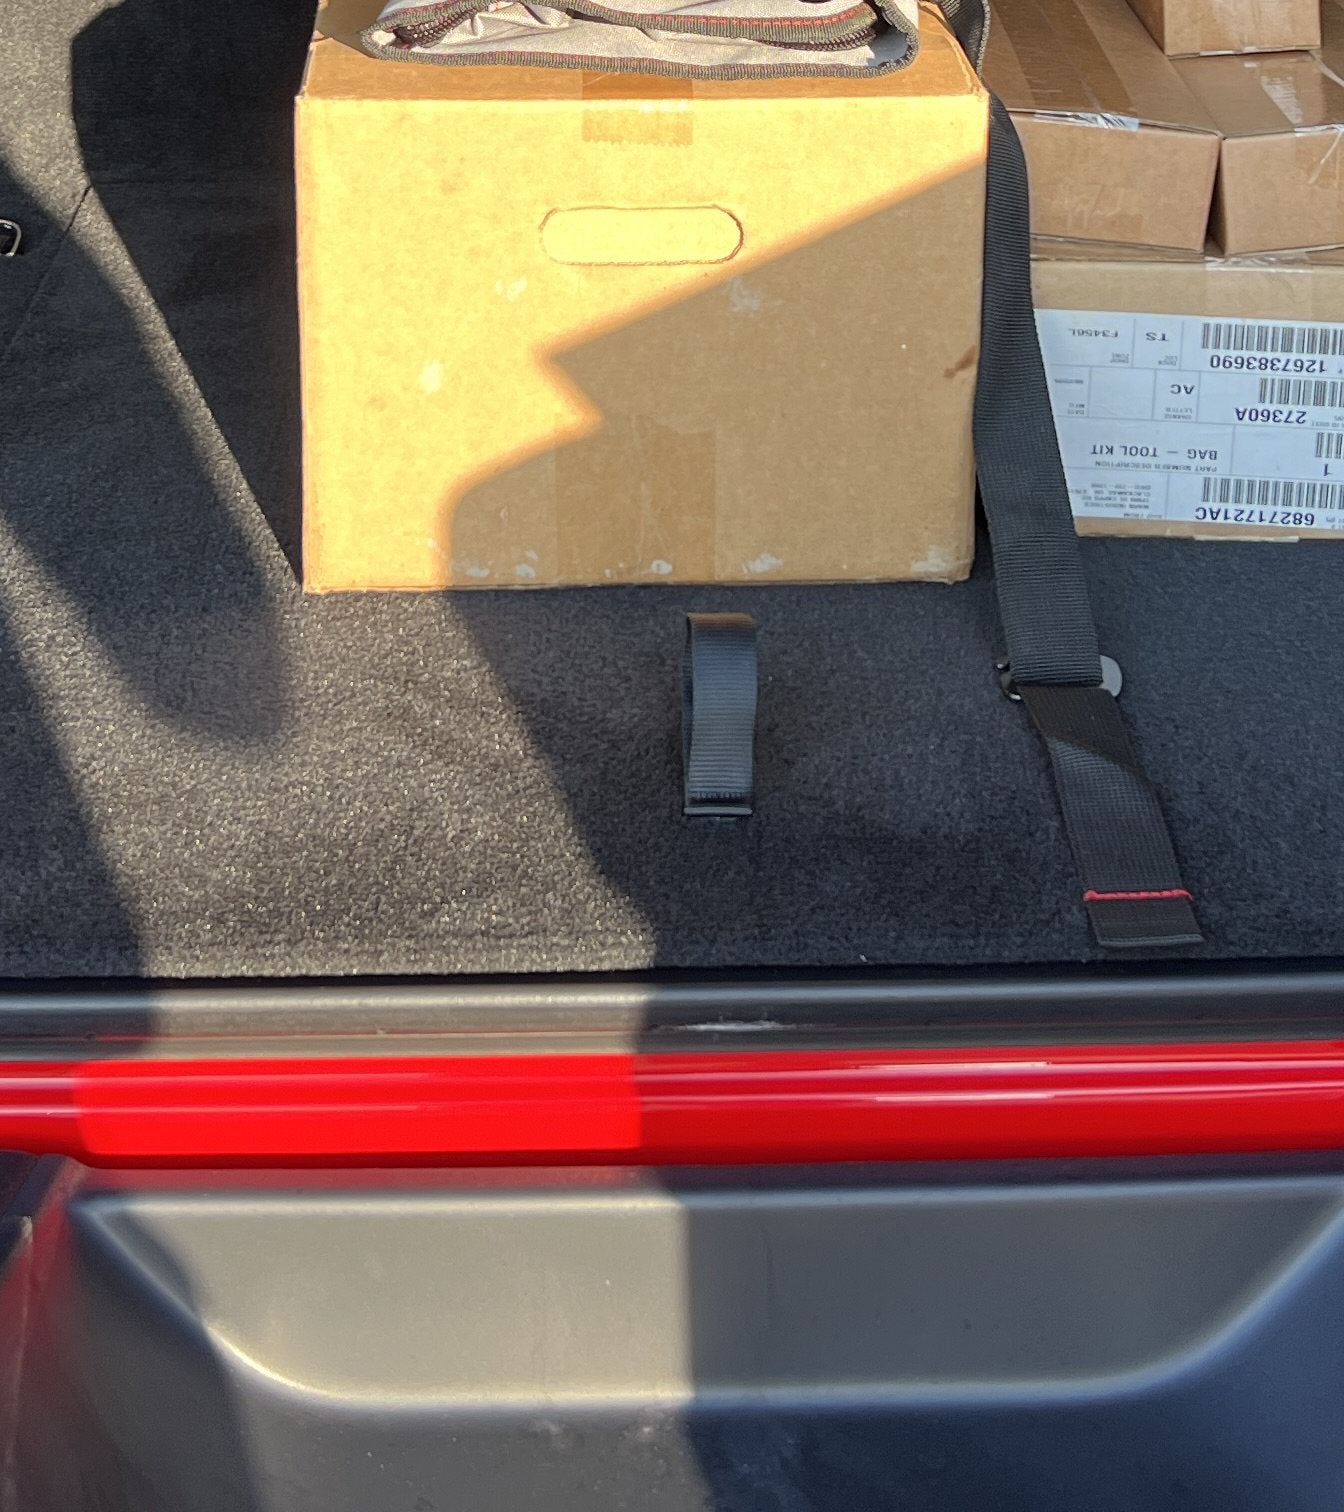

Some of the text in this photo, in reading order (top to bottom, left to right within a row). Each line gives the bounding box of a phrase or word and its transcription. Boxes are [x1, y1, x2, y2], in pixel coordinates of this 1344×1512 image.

[1146, 332, 1168, 342] TS
[1210, 355, 1326, 373] 1267383690
[1170, 384, 1195, 395] AC
[1235, 408, 1307, 424] 27360A
[1089, 445, 1114, 456] KIT
[1119, 445, 1158, 458] TOOL
[1187, 449, 1218, 461] BAG
[1323, 464, 1333, 477] 1
[1195, 507, 1316, 526] 68271721AC
